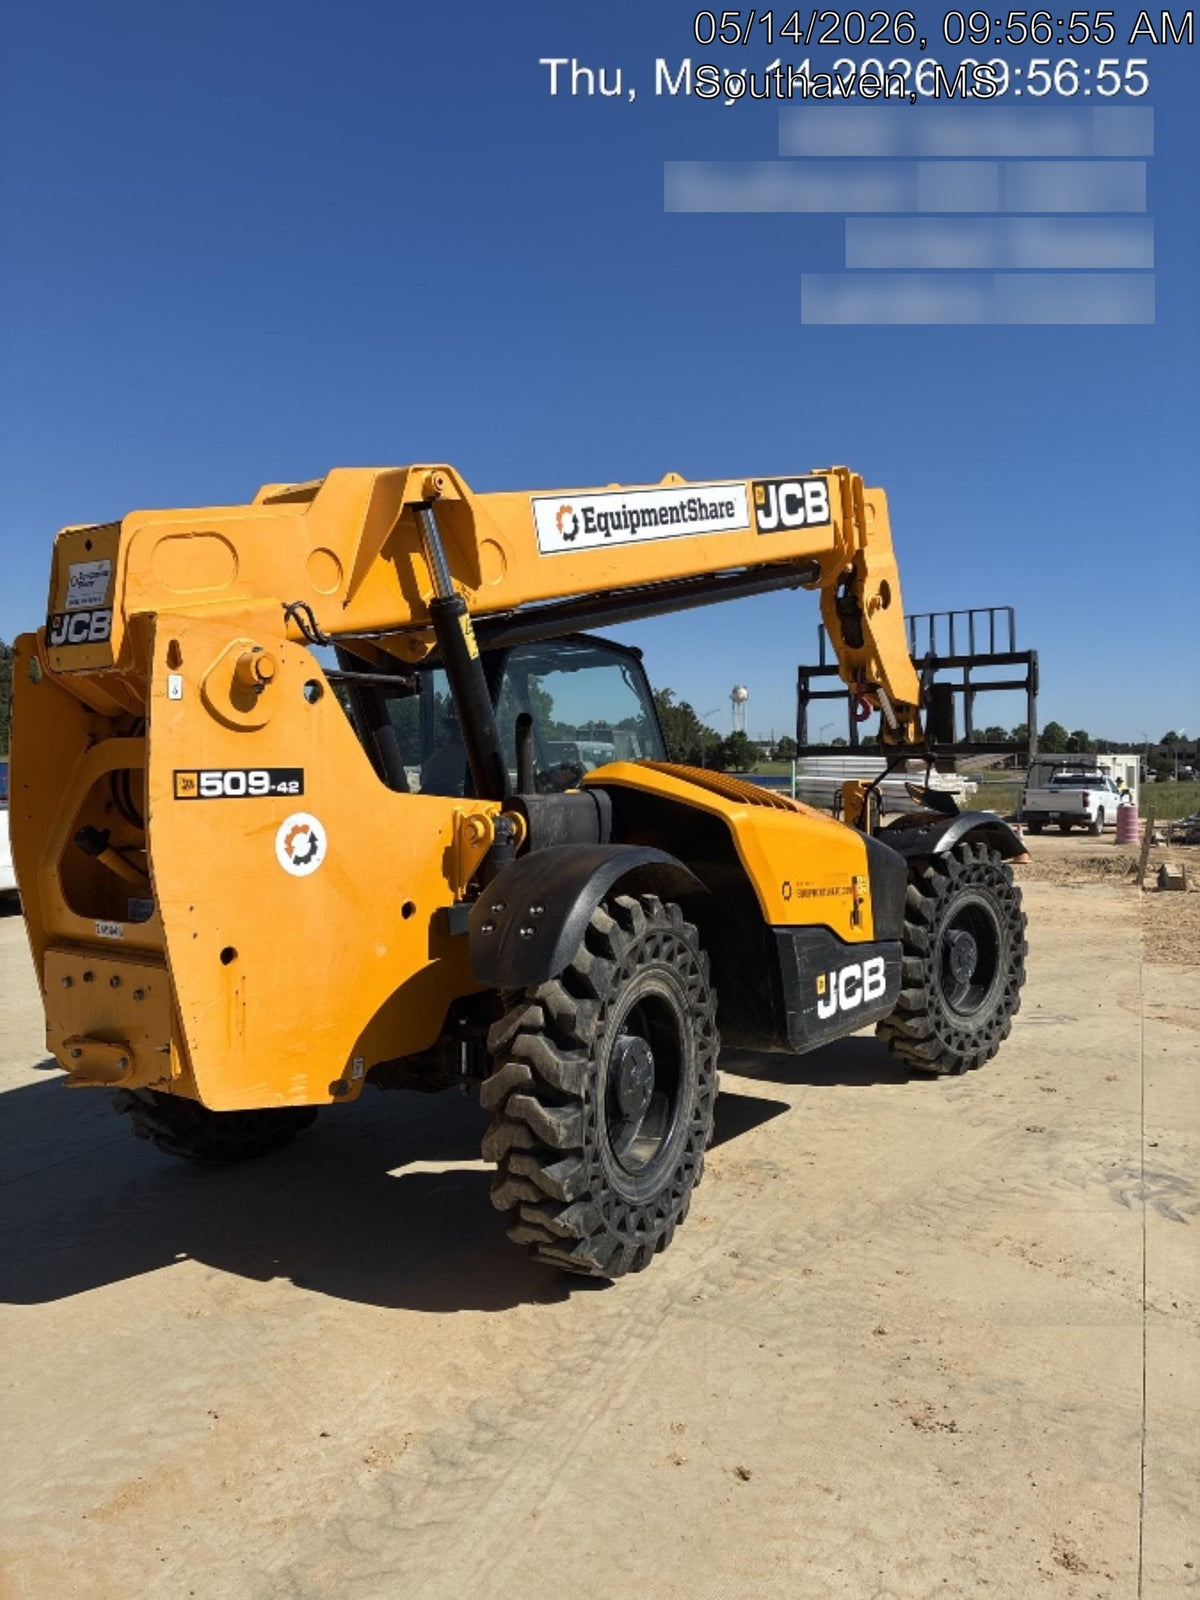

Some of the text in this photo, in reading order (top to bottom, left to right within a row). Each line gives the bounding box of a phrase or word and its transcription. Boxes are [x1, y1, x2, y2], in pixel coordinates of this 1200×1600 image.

[581, 497, 735, 537] EquipmentShare
[758, 481, 829, 529] JCB
[50, 610, 111, 645] JCB
[816, 956, 887, 1020] JCB
